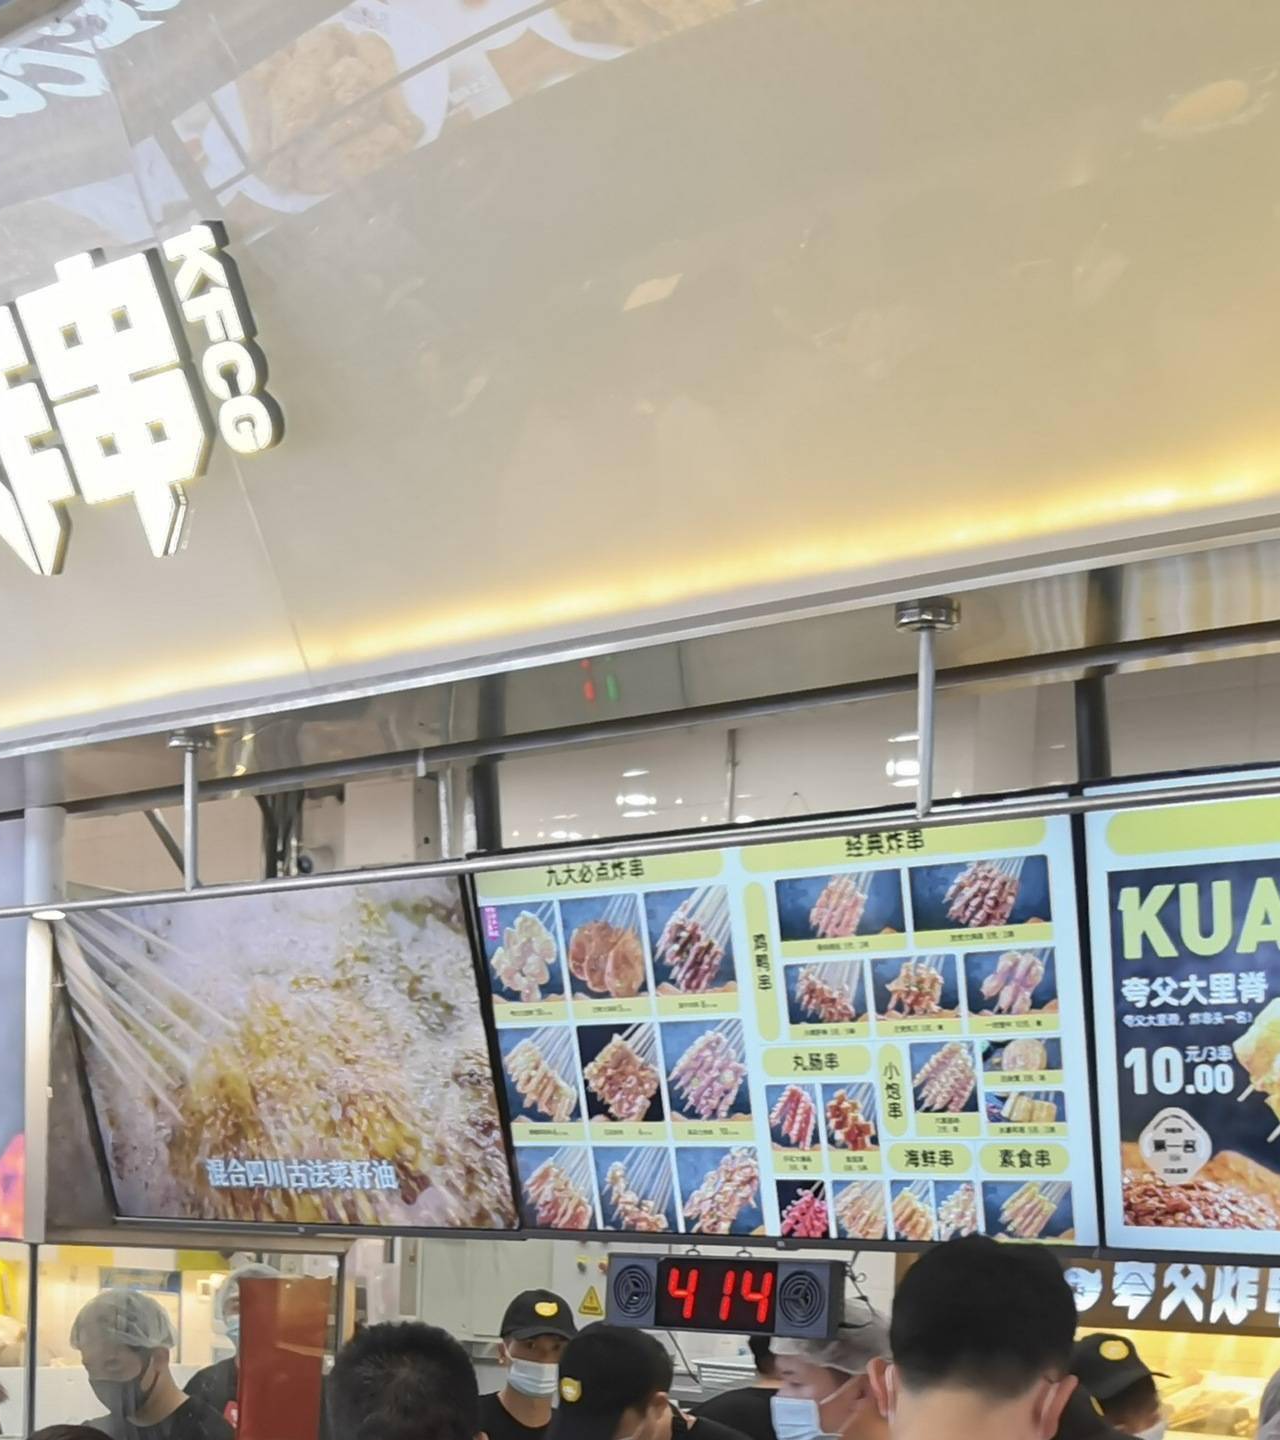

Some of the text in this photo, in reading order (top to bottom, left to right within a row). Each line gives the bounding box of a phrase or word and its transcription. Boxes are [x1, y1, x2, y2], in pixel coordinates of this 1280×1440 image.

[546, 859, 645, 887] 九大必点炸串
[1121, 971, 1269, 1008] 夸父大里脊
[1123, 1046, 1235, 1095] 10.00
[904, 1149, 955, 1168] 海鲜串
[999, 1149, 1052, 1168] 素食串
[207, 1159, 398, 1191] 混合四川古法菜籽油
